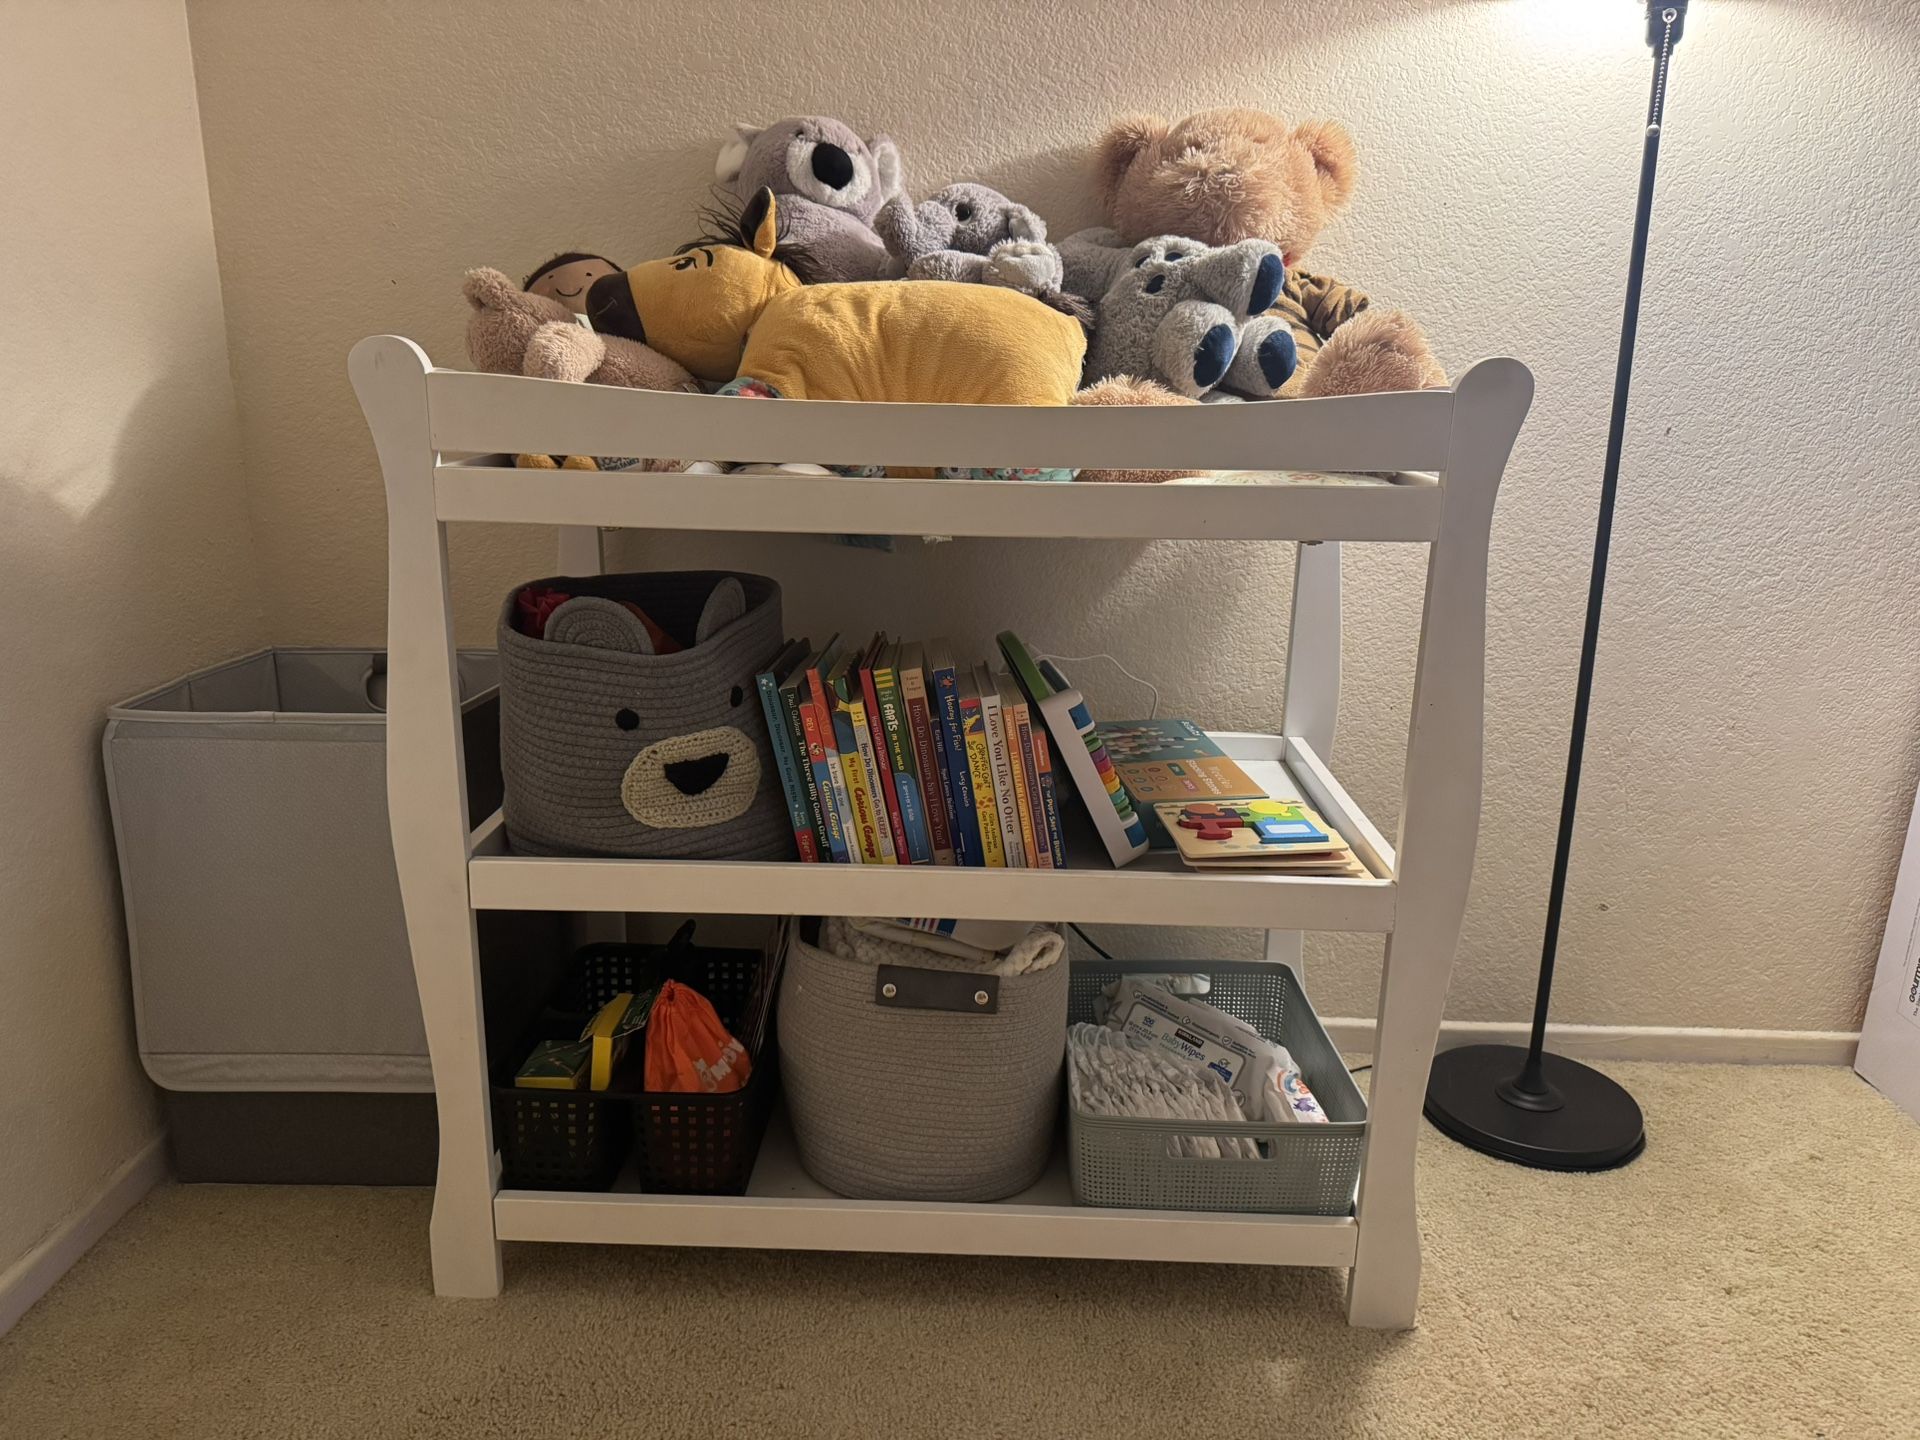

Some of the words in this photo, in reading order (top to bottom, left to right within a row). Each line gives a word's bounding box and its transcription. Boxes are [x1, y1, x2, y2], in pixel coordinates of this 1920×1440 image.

[786, 693, 795, 708] Paul
[943, 694, 957, 721] Hooray
[790, 710, 801, 736] Galdone
[912, 704, 923, 723] How
[916, 725, 925, 738] Do
[948, 721, 959, 734] for
[987, 710, 1001, 738] Love
[1020, 725, 1029, 740] How
[883, 703, 898, 731] FARTS
[895, 755, 904, 770] WILD
[936, 741, 944, 752] Hill
[951, 734, 962, 752] Fish!
[1023, 741, 1031, 752] Do
[797, 740, 807, 756] The
[860, 742, 870, 757] How
[975, 742, 989, 771] GIRAFFES
[992, 739, 1005, 761] You
[801, 756, 813, 782] Three
[847, 757, 856, 767] My
[864, 757, 871, 767] Do
[919, 739, 934, 780] Dinosaurs
[969, 752, 981, 778] DANCE
[1009, 750, 1020, 774] LLAMA
[1025, 753, 1036, 785] Dinosaurs
[831, 768, 839, 784] brave
[850, 769, 860, 784] First
[866, 768, 879, 798] Dinosaurs
[956, 770, 968, 786] Lucy
[981, 772, 991, 789] CAN'T
[996, 762, 1009, 786] Like
[807, 782, 817, 800] Billy
[926, 781, 936, 796] Say
[1013, 774, 1025, 797] LLAMA
[1030, 785, 1040, 805] Clean
[853, 786, 871, 824] Curious
[872, 798, 880, 808] Go
[961, 786, 970, 807] Cousins
[1000, 788, 1011, 804] No
[811, 802, 822, 824] Goats
[821, 779, 835, 811] Curious
[828, 811, 843, 840] George
[875, 808, 882, 816] to
[930, 802, 941, 822] Love
[980, 810, 988, 822] Guy
[1046, 798, 1055, 815] PUPS
[987, 813, 995, 826] Giles
[1003, 805, 1016, 835] Otter
[1048, 815, 1058, 831] SAVE
[800, 833, 812, 854] tiger
[817, 825, 828, 847] Gruff
[861, 824, 878, 859] George
[934, 824, 945, 846] You?
[1161, 1032, 1181, 1048] Baby
[1180, 1041, 1206, 1061] Wipes
